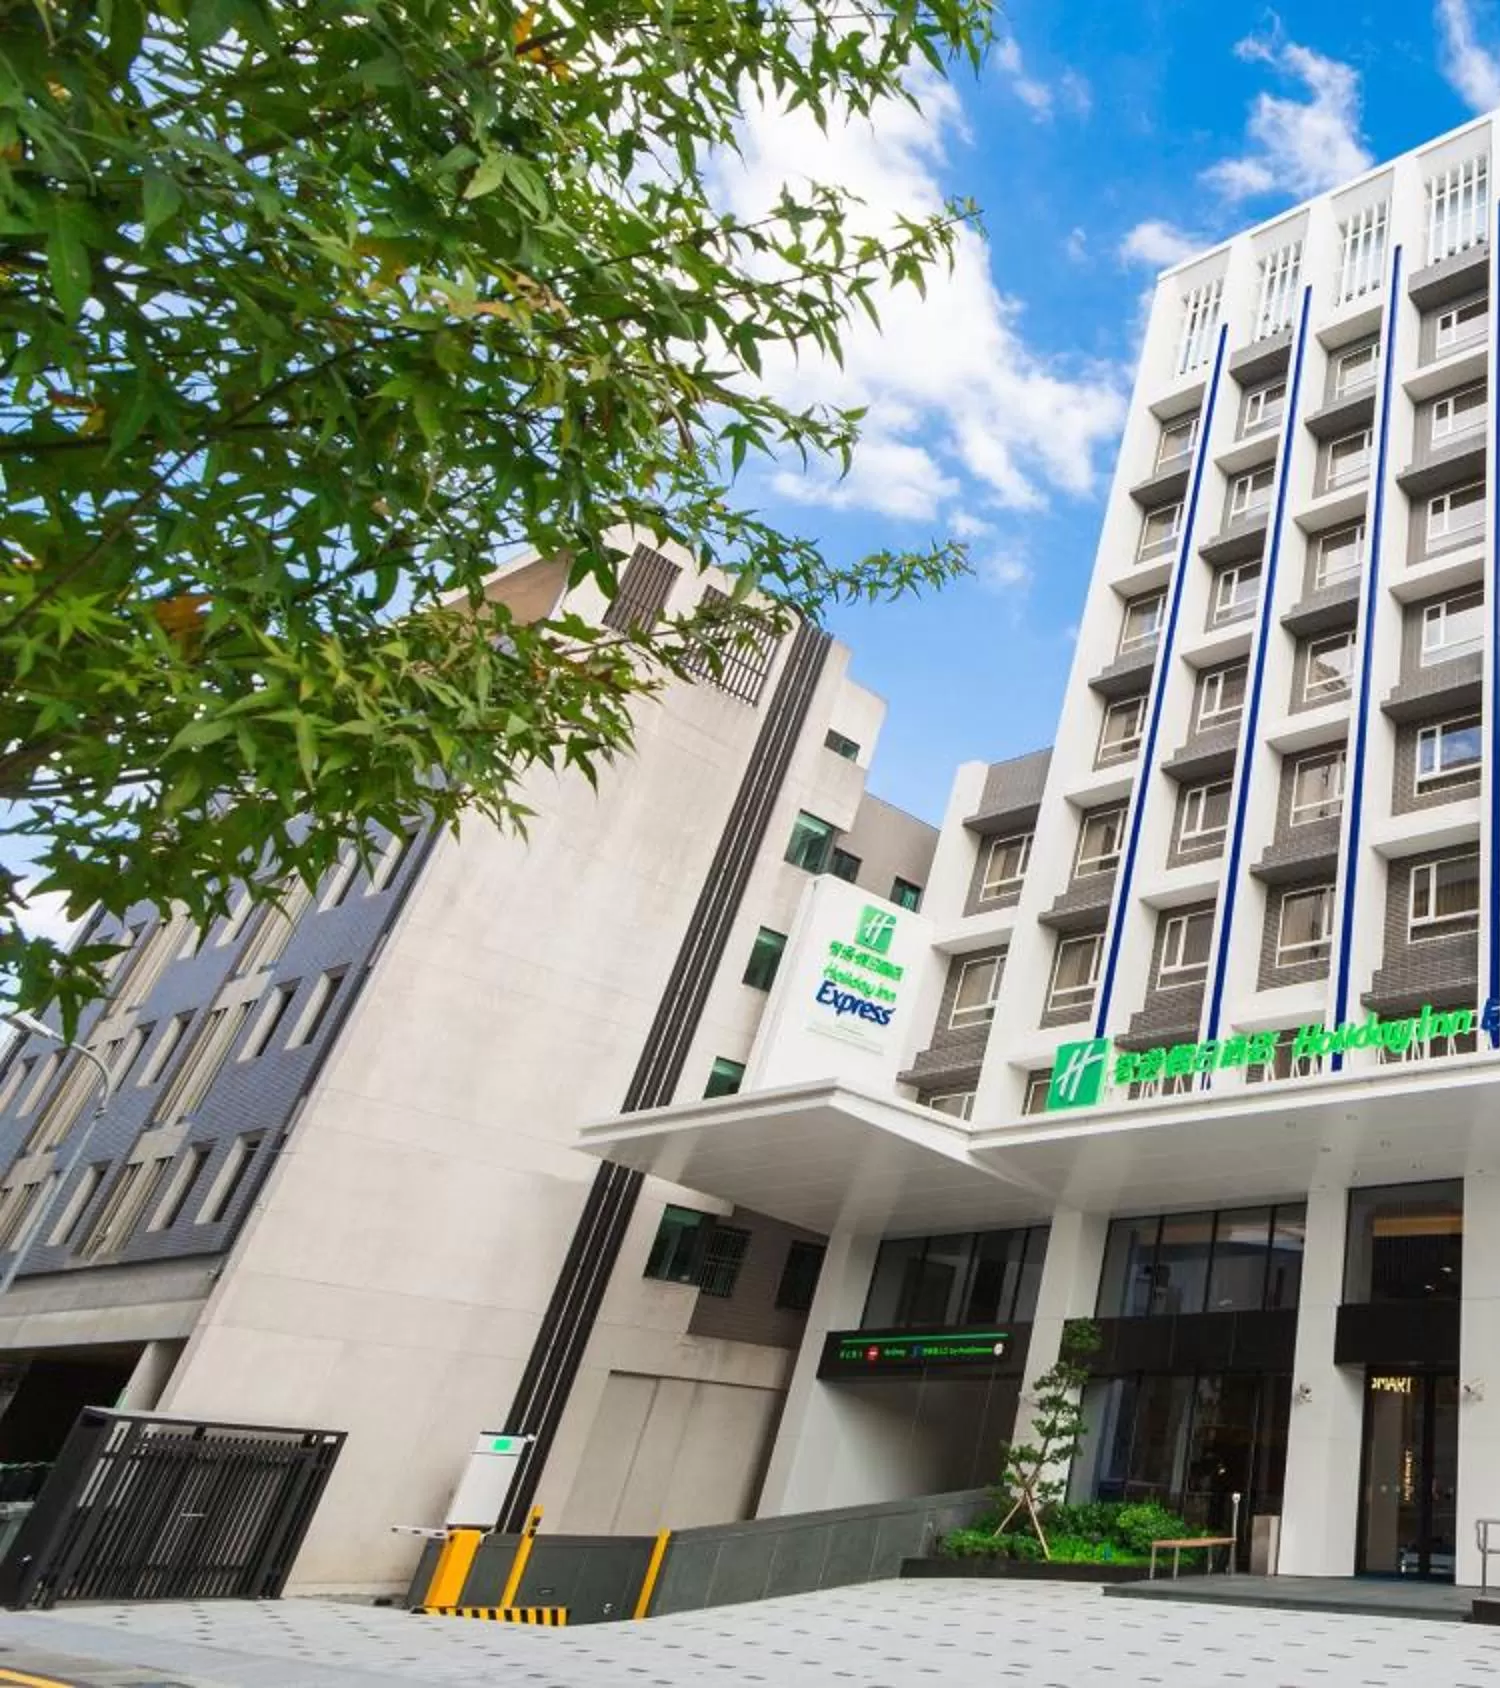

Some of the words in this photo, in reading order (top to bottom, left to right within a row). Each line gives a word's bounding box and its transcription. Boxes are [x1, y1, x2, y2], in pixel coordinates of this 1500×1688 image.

[815, 980, 897, 1026] Express
[823, 964, 877, 998] Holiday
[1293, 1012, 1415, 1057] Holiday
[1416, 1004, 1473, 1040] Inn
